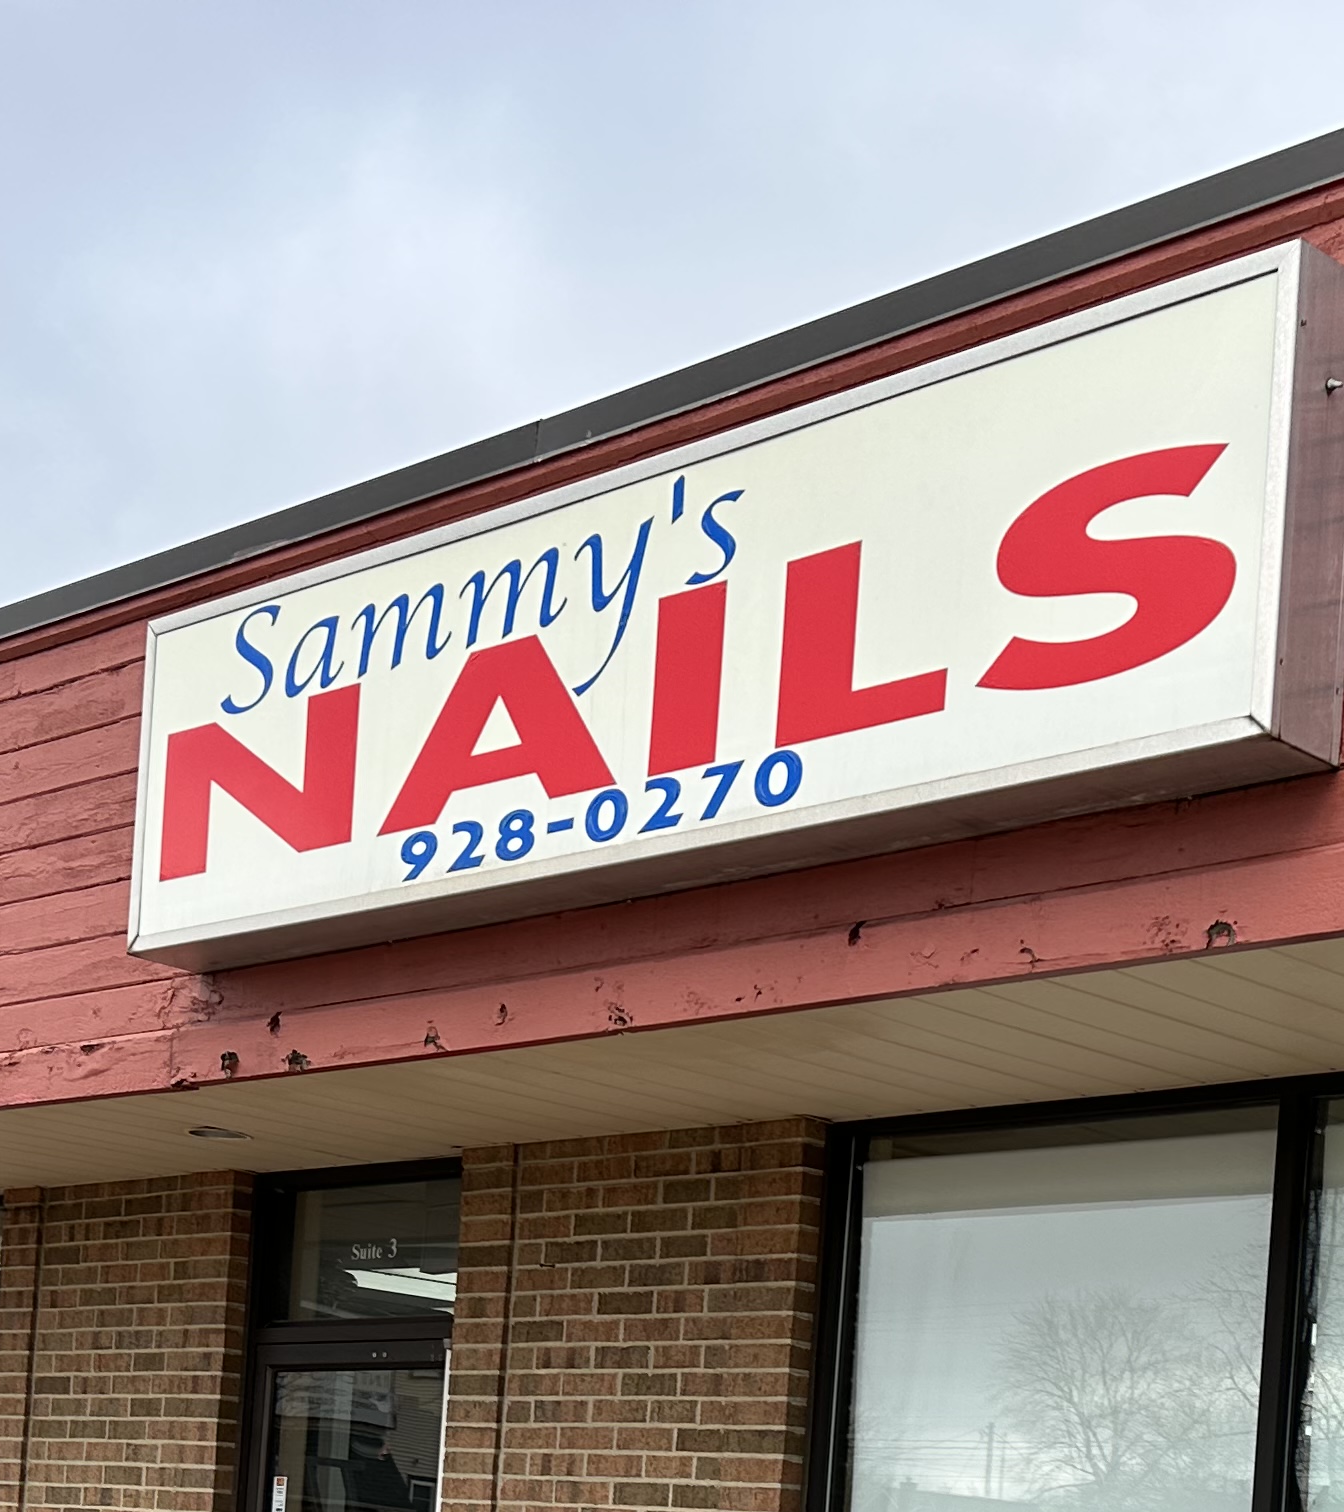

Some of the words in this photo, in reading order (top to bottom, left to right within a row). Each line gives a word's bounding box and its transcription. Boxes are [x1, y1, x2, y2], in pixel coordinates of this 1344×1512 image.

[158, 441, 1238, 883] NAILS
[219, 475, 746, 714] Sammy's
[400, 750, 803, 882] 928-0270
[351, 1243, 383, 1260] Suite
[388, 1238, 397, 1258] 3
